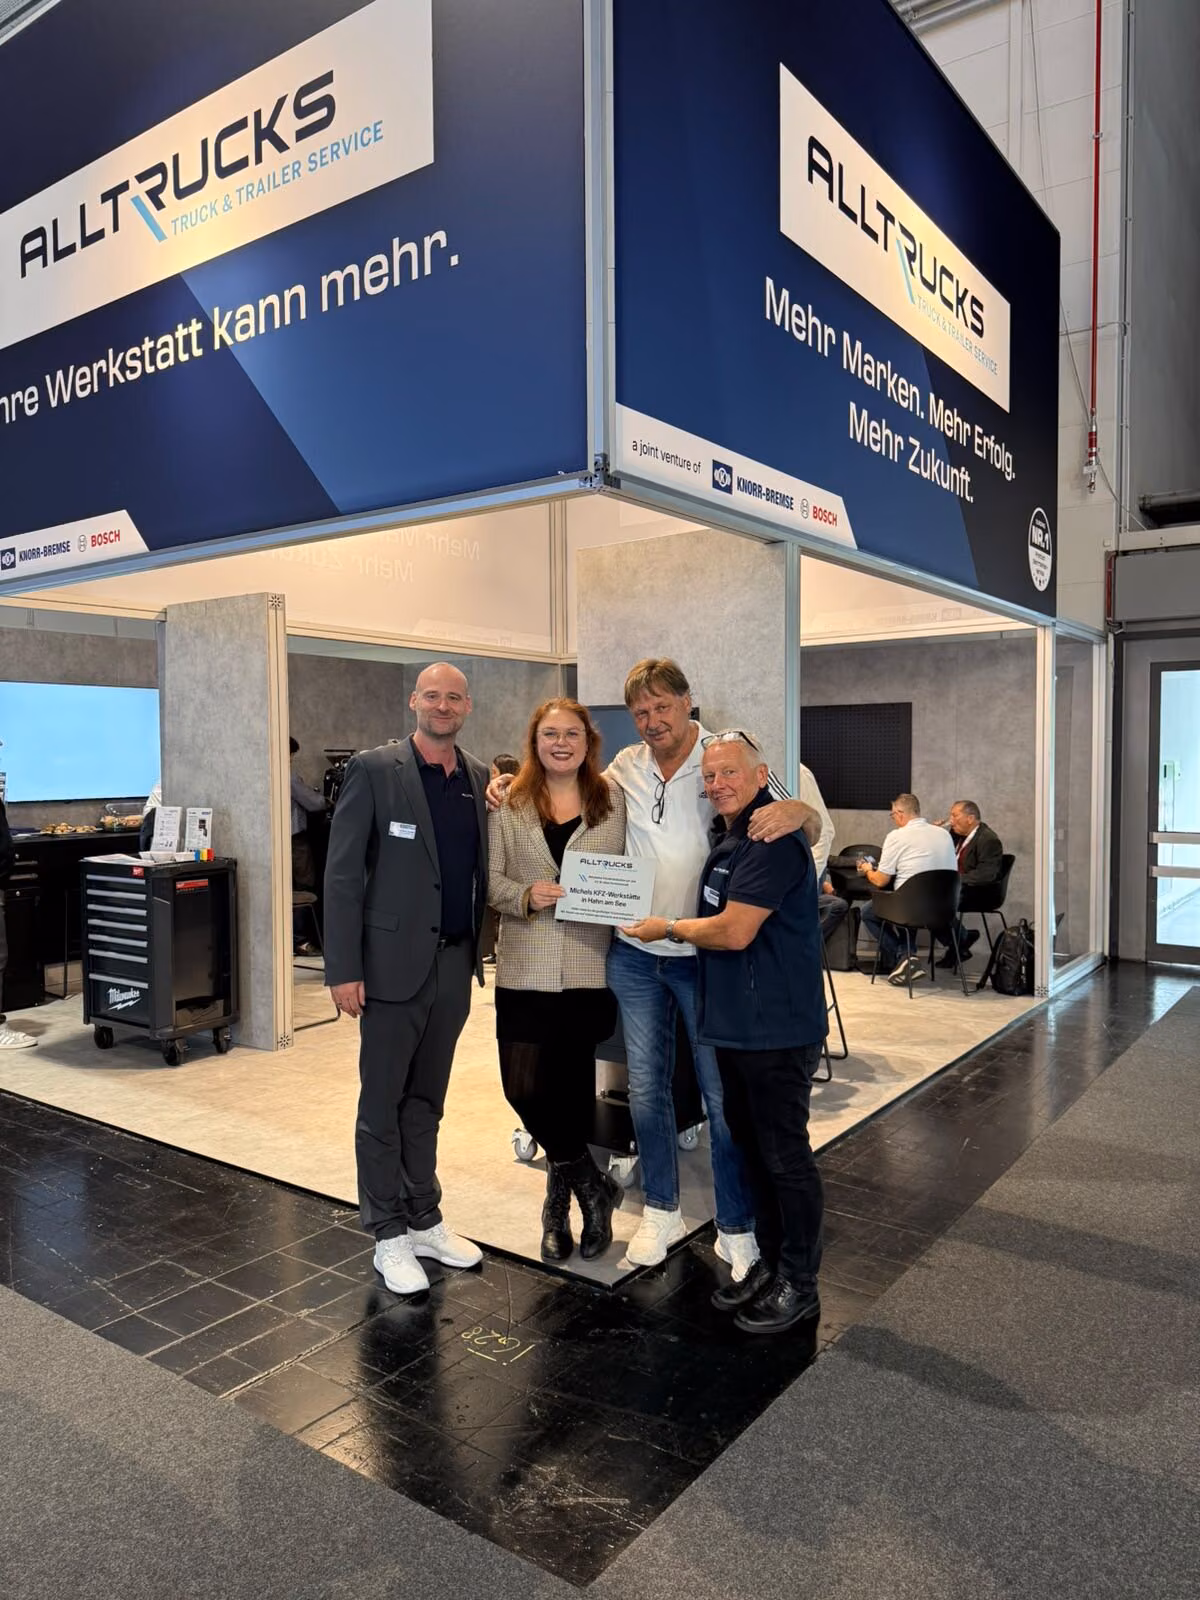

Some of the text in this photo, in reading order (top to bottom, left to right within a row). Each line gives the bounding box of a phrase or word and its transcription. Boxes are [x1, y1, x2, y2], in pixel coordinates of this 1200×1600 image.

[20, 69, 336, 279] ALLTRUCKS
[171, 119, 384, 237] TRUCK & TRAILER SERVICE
[807, 135, 984, 339] ALLTRUCKS
[45, 317, 203, 408] Werkstatt
[213, 284, 307, 351] kann
[321, 229, 460, 313] mehr.
[918, 294, 941, 326] TRUCK
[947, 321, 973, 353] TRAILER
[974, 345, 998, 376] SERVICE
[765, 275, 1016, 480] Mehr Marken. Mehr Erfolg.
[632, 439, 701, 474] a joint venture of
[849, 401, 975, 503] Mehr Zukunft.
[737, 476, 795, 511] KNORR-BREMSE
[813, 505, 838, 527] BOSCH
[19, 540, 71, 562] KNORR-BREMSE
[91, 529, 121, 547] BOSCH
[580, 858, 633, 869] ALLTRUCKS
[570, 887, 592, 896] Michels
[588, 897, 603, 905] Hahn
